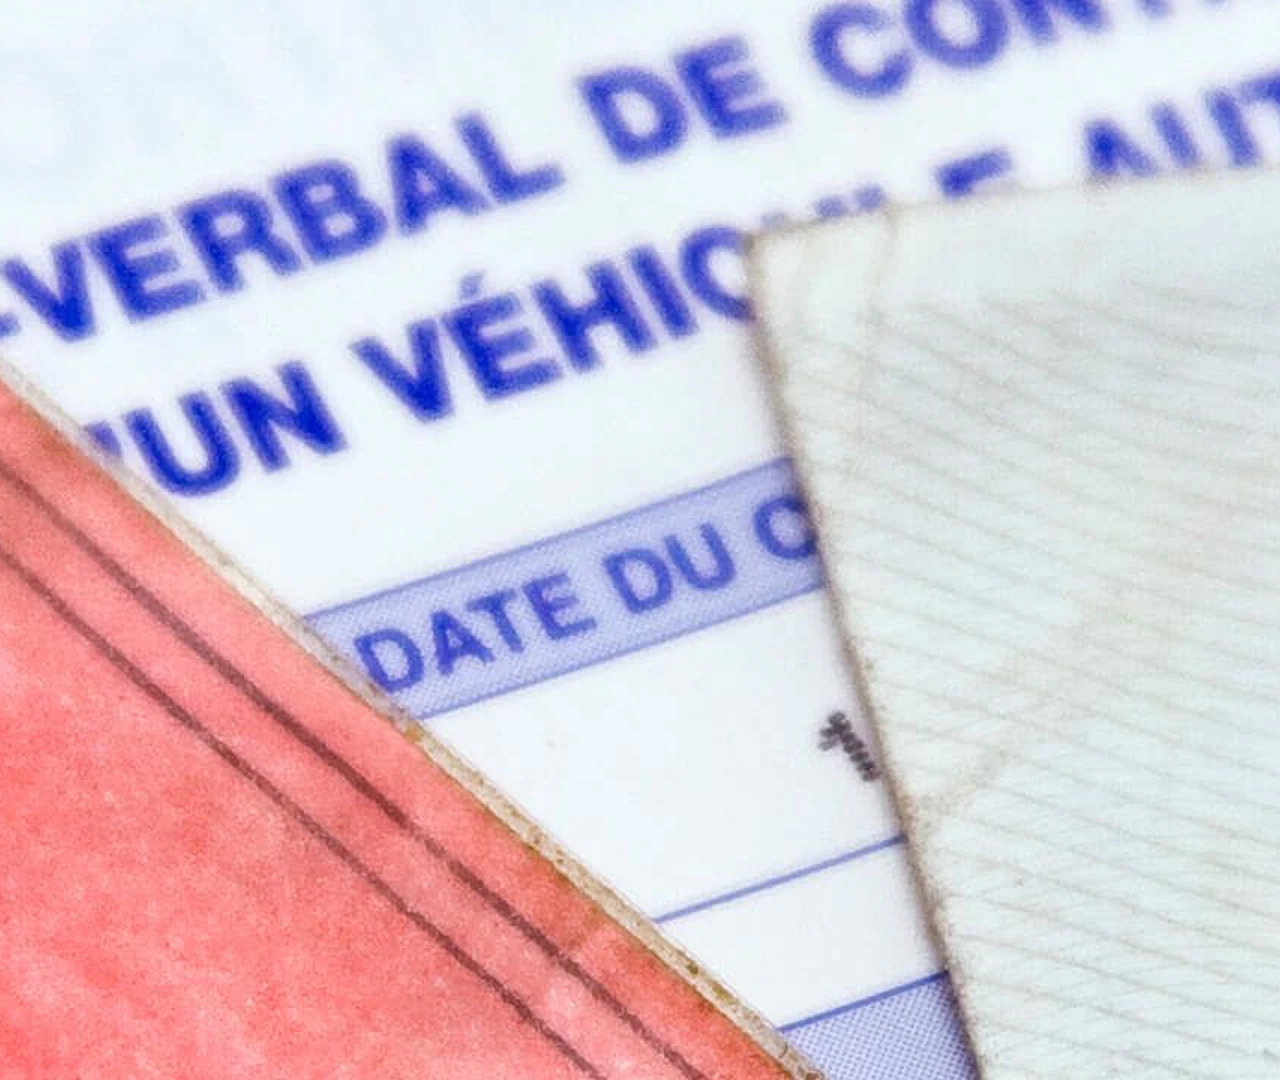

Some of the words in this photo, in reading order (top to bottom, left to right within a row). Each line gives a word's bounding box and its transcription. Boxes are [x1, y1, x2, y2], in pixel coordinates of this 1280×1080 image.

[576, 36, 788, 165] DE
[808, 0, 1172, 99] CO
[353, 573, 596, 696] DATE
[601, 523, 736, 615] DU
